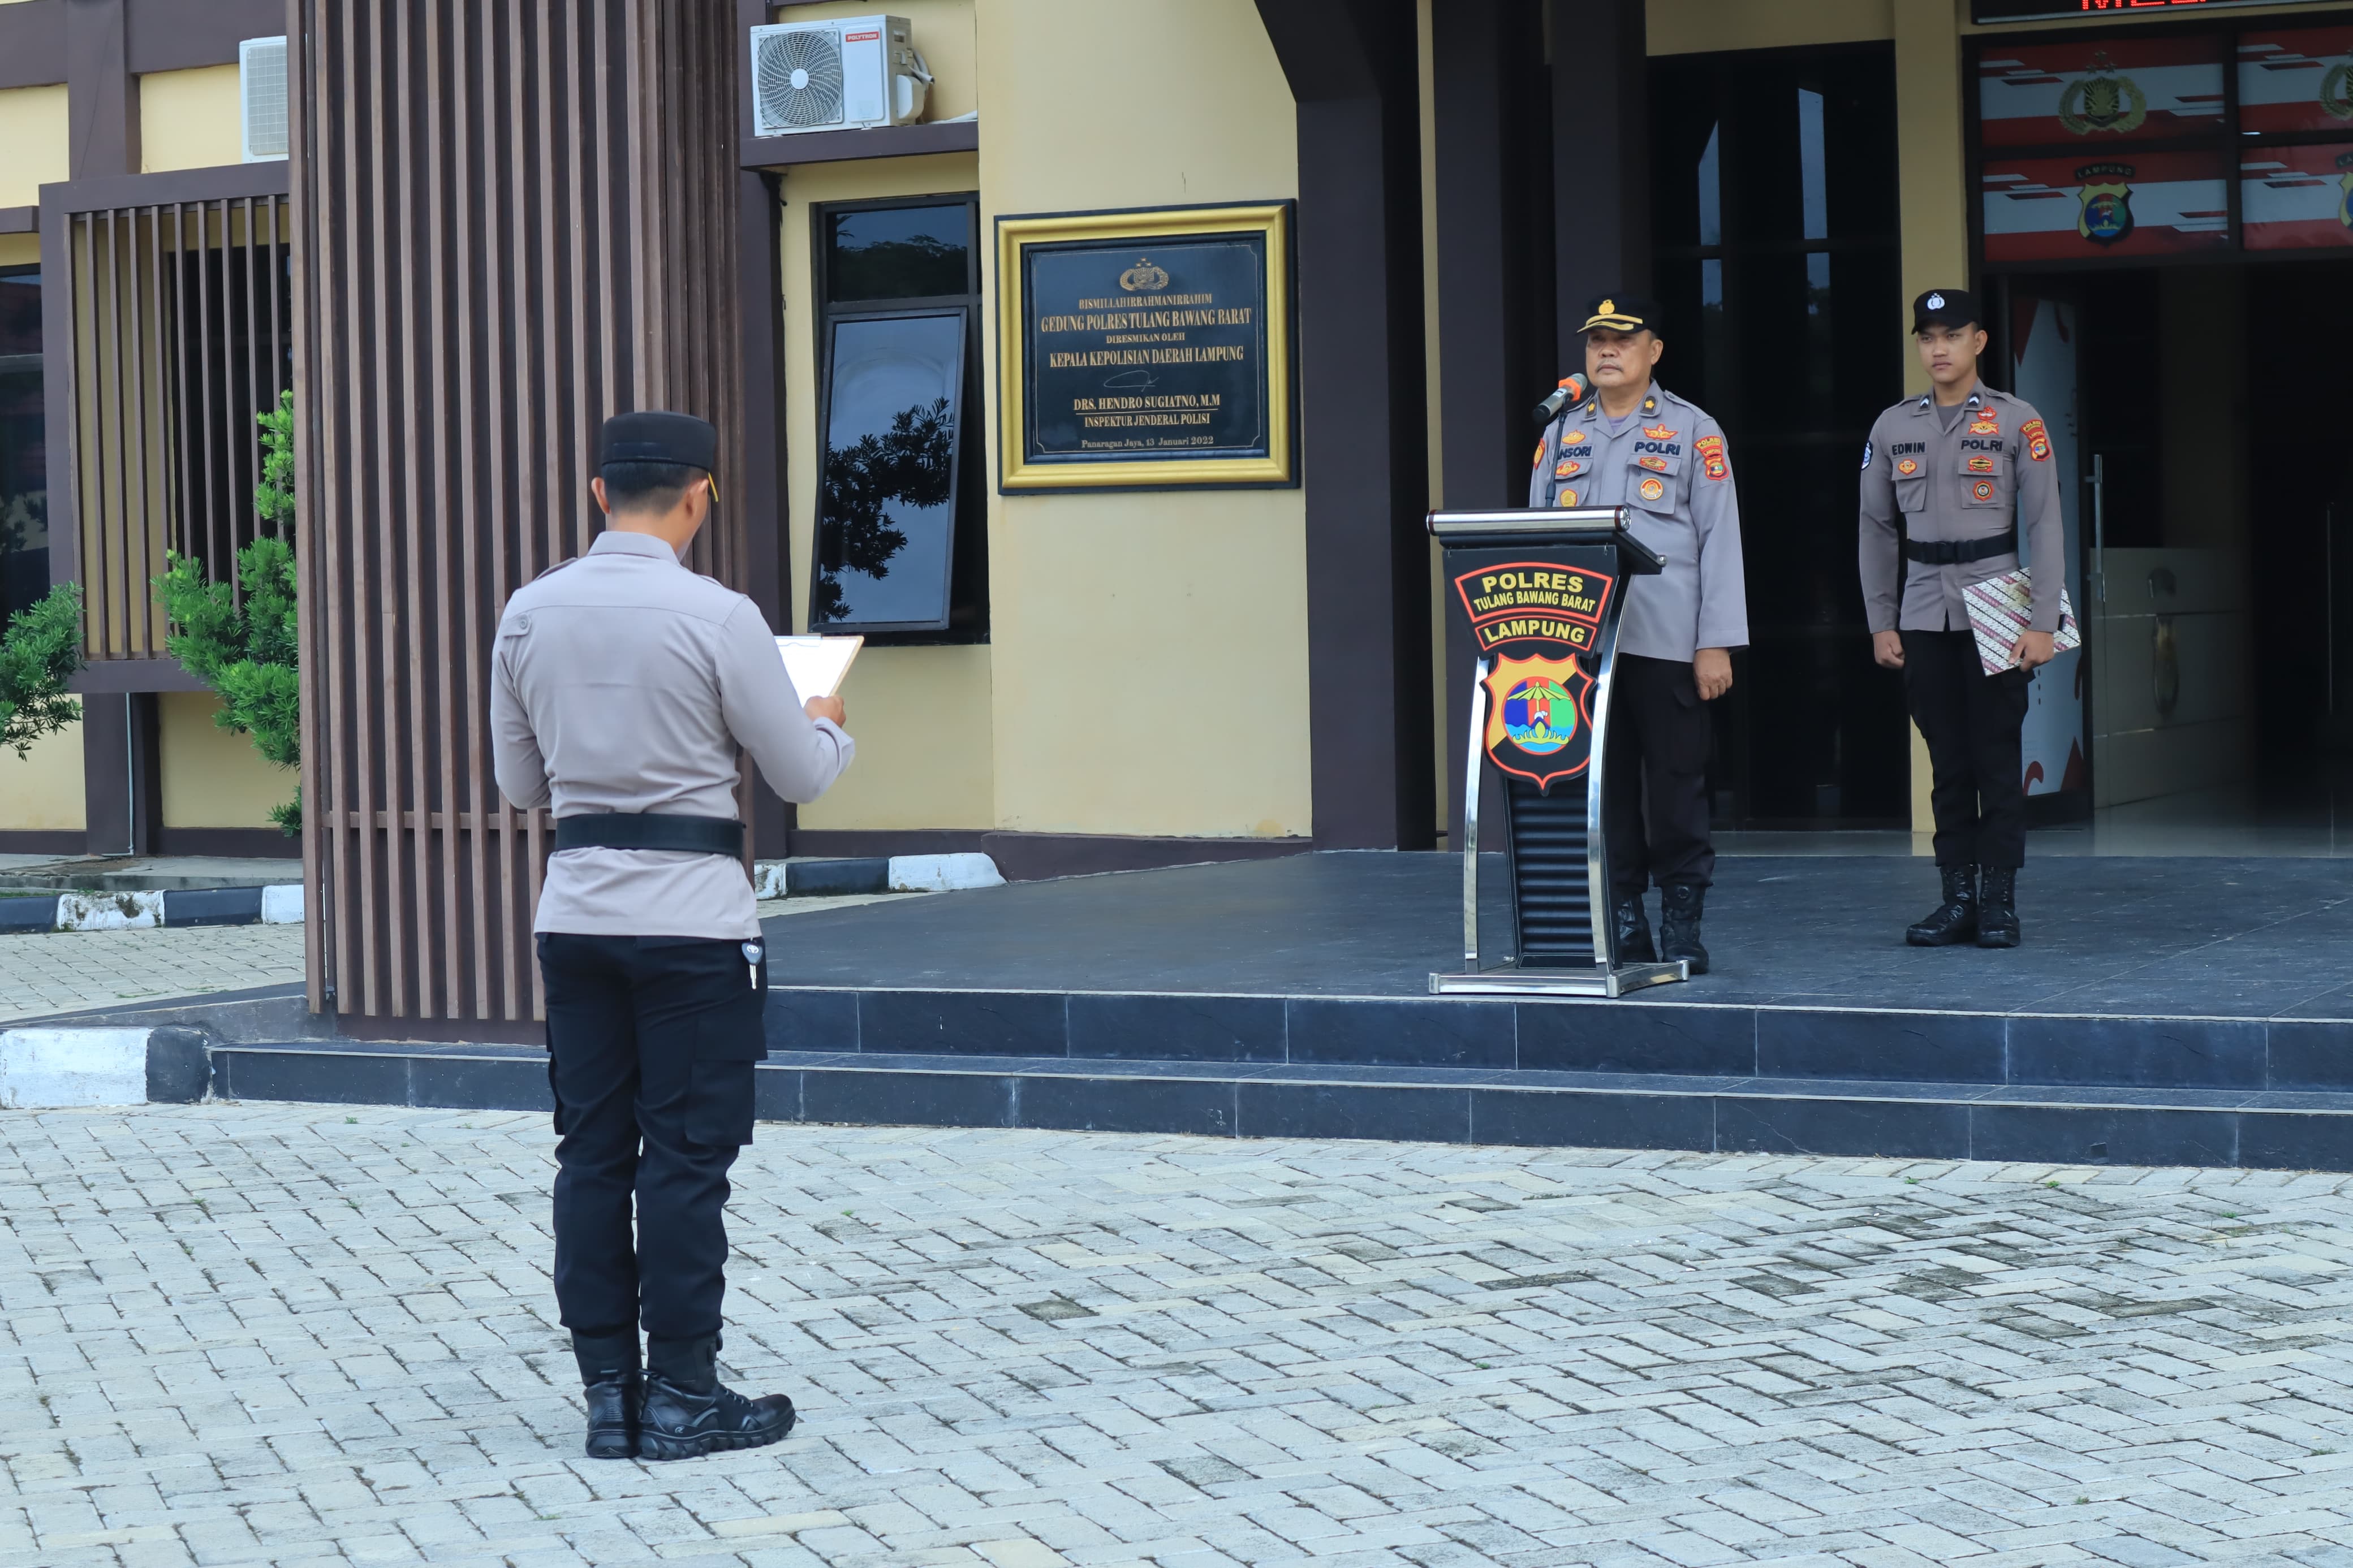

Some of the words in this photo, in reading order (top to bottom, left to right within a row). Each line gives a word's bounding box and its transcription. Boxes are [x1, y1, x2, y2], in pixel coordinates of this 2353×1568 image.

[1079, 293, 1212, 310] BISMILLAHIRRAHMANIRRAHIM
[1041, 315, 1084, 332] GEDUNG
[1087, 313, 1128, 330] POLRES
[1128, 310, 1170, 329] TULANG
[1172, 309, 1215, 327] BAWANG
[1218, 308, 1252, 325] BARAT
[1106, 333, 1160, 344] DIRESMIKAN
[1162, 332, 1186, 342] OLEH
[1050, 352, 1087, 368] KEPALA
[1089, 349, 1149, 366] KEPOLISIAN
[1152, 347, 1192, 364] DAERAH
[1195, 345, 1244, 362] LAMPUNG
[1074, 398, 1096, 411] DRS.
[1099, 396, 1143, 410] HENDRO
[1145, 395, 1199, 408] SUGIATNO,
[1200, 394, 1220, 406] M.M
[1084, 415, 1132, 427] INSPEKTUR
[1134, 414, 1179, 426] JENDERAL
[1181, 413, 1210, 424] POLISI
[1081, 440, 1122, 450] Panaragan
[1124, 439, 1144, 448] Jaya,
[1147, 438, 1154, 447] 13
[1158, 437, 1189, 446] Januari
[1191, 435, 1214, 445] 2022
[1634, 442, 1681, 456] POLRI
[1891, 442, 1925, 455] EDWIN
[1961, 439, 2003, 451] POLRI
[1482, 572, 1583, 593] POLRES
[1473, 592, 1514, 611] TULANG
[1516, 591, 1559, 606] BAWANG
[1561, 594, 1596, 612] BARAT
[1484, 620, 1585, 643] LAMPUNG
